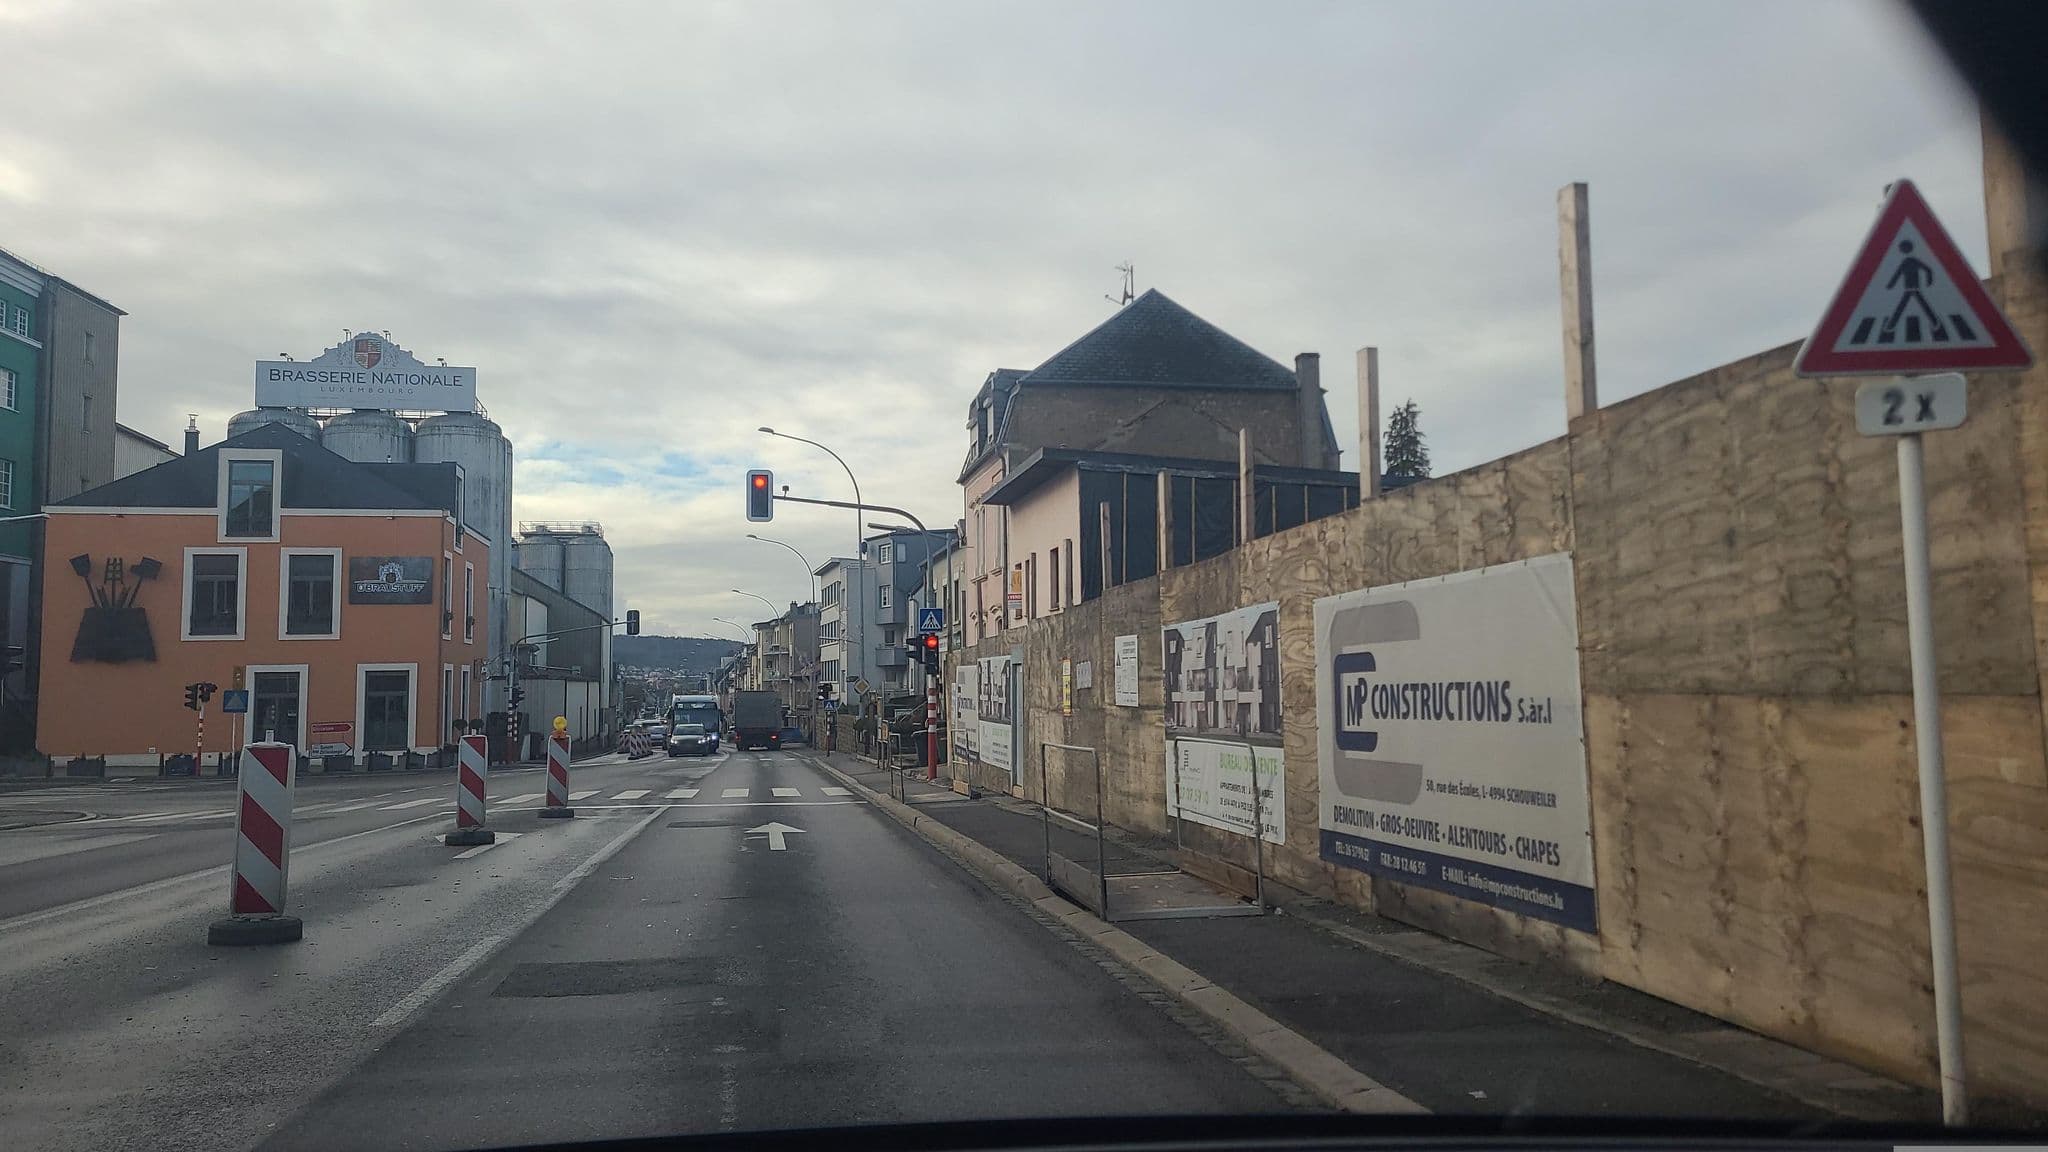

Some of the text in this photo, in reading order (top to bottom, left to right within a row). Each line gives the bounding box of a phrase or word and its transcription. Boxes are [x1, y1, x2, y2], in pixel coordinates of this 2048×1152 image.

[269, 368, 463, 387] BRASSERIE NATIONALE
[320, 386, 414, 395] LUXEMBOURG
[1882, 386, 1904, 426] 2
[1371, 680, 1512, 723] CONSTRUCTIONS
[1436, 781, 1447, 793] rue
[1448, 781, 1458, 795] des
[1333, 805, 1560, 867] DEMOLITION GROS-OEUVRE ALENTOURS CHAPES
